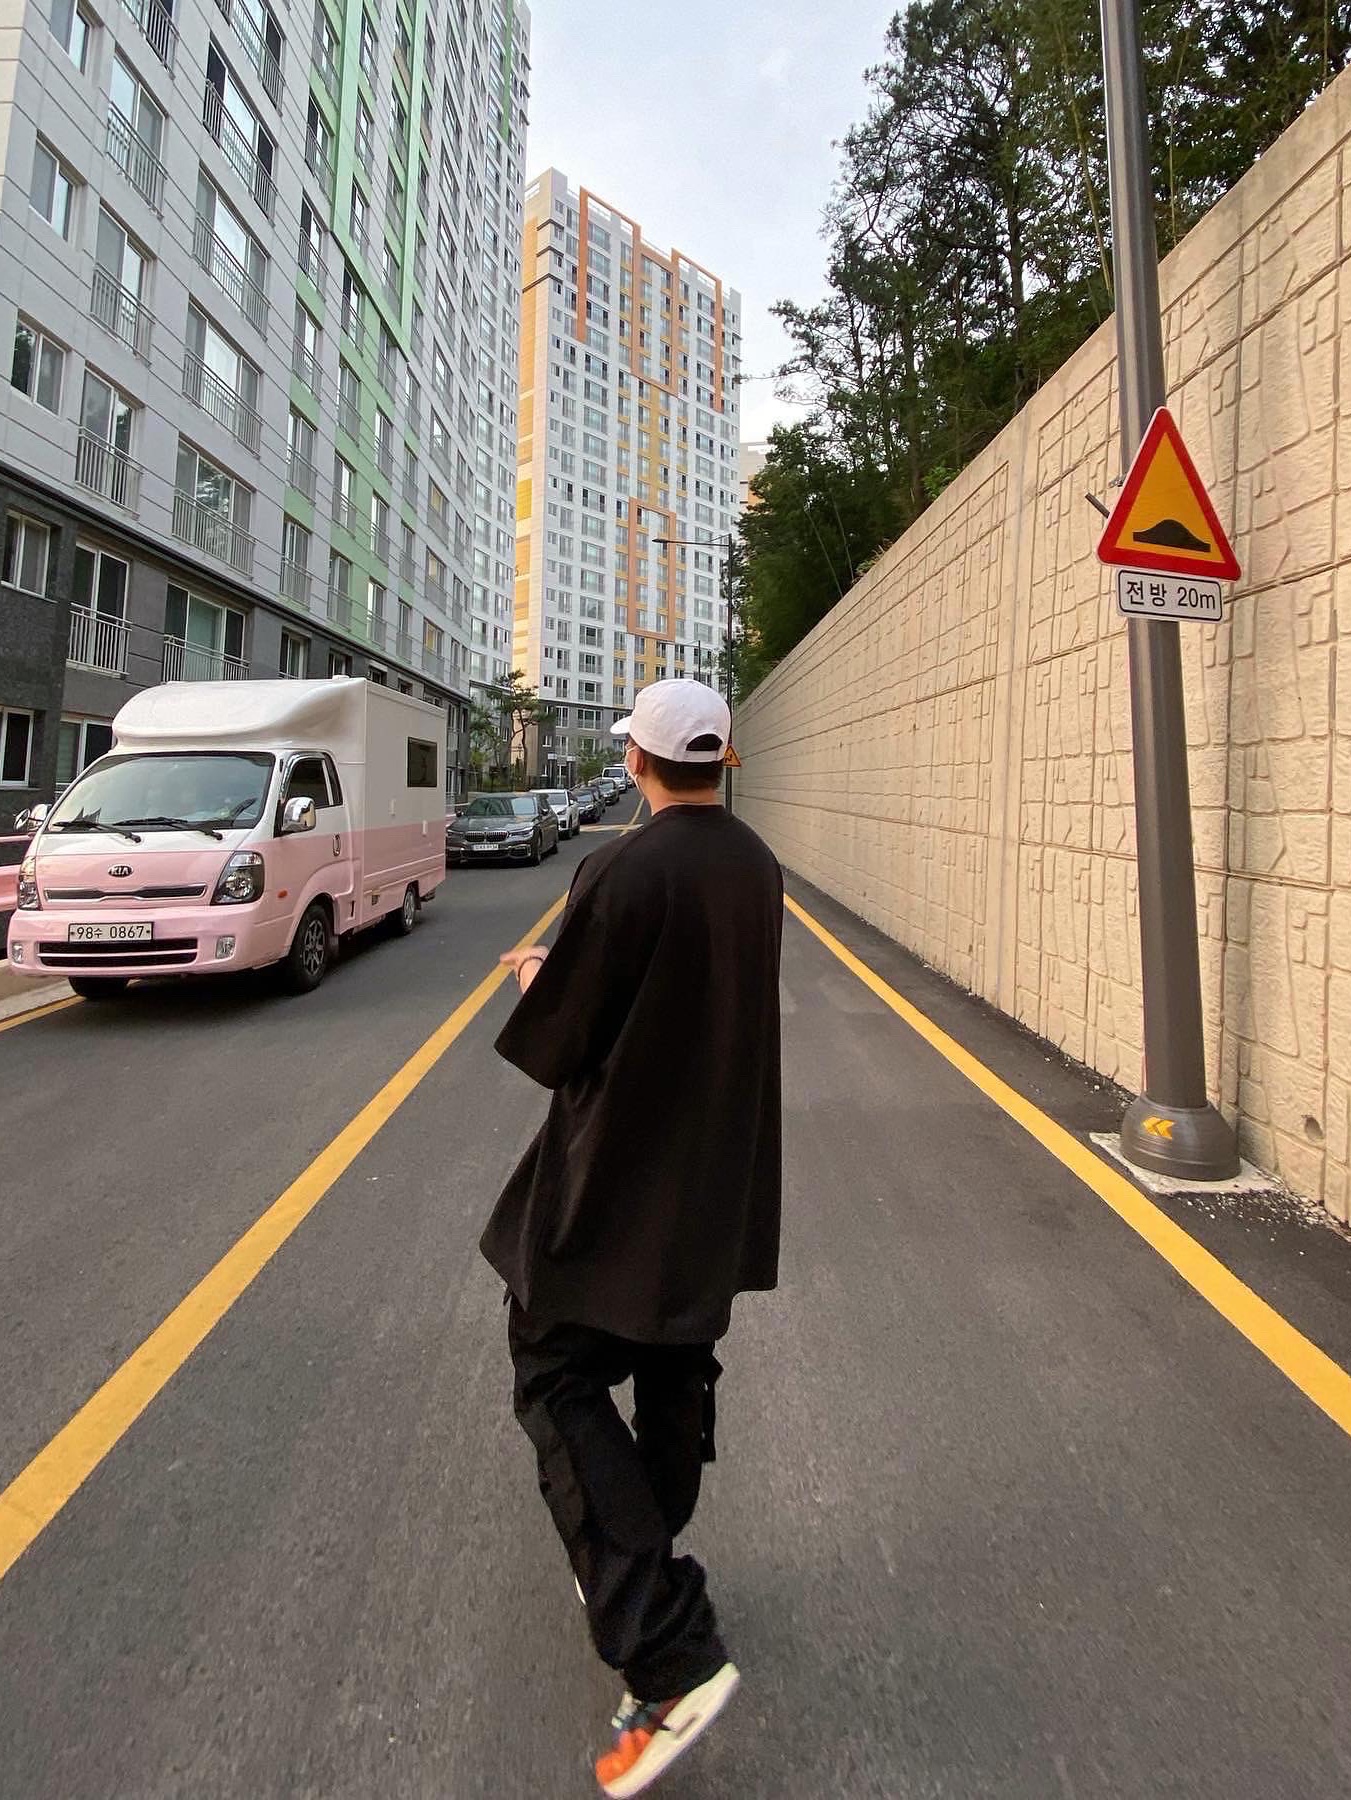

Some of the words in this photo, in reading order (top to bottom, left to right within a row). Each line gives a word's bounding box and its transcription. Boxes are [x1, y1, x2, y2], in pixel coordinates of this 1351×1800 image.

[1126, 580, 1167, 607] 전방
[1177, 586, 1217, 610] 20m
[109, 866, 130, 875] KIA
[109, 925, 145, 939] 0867
